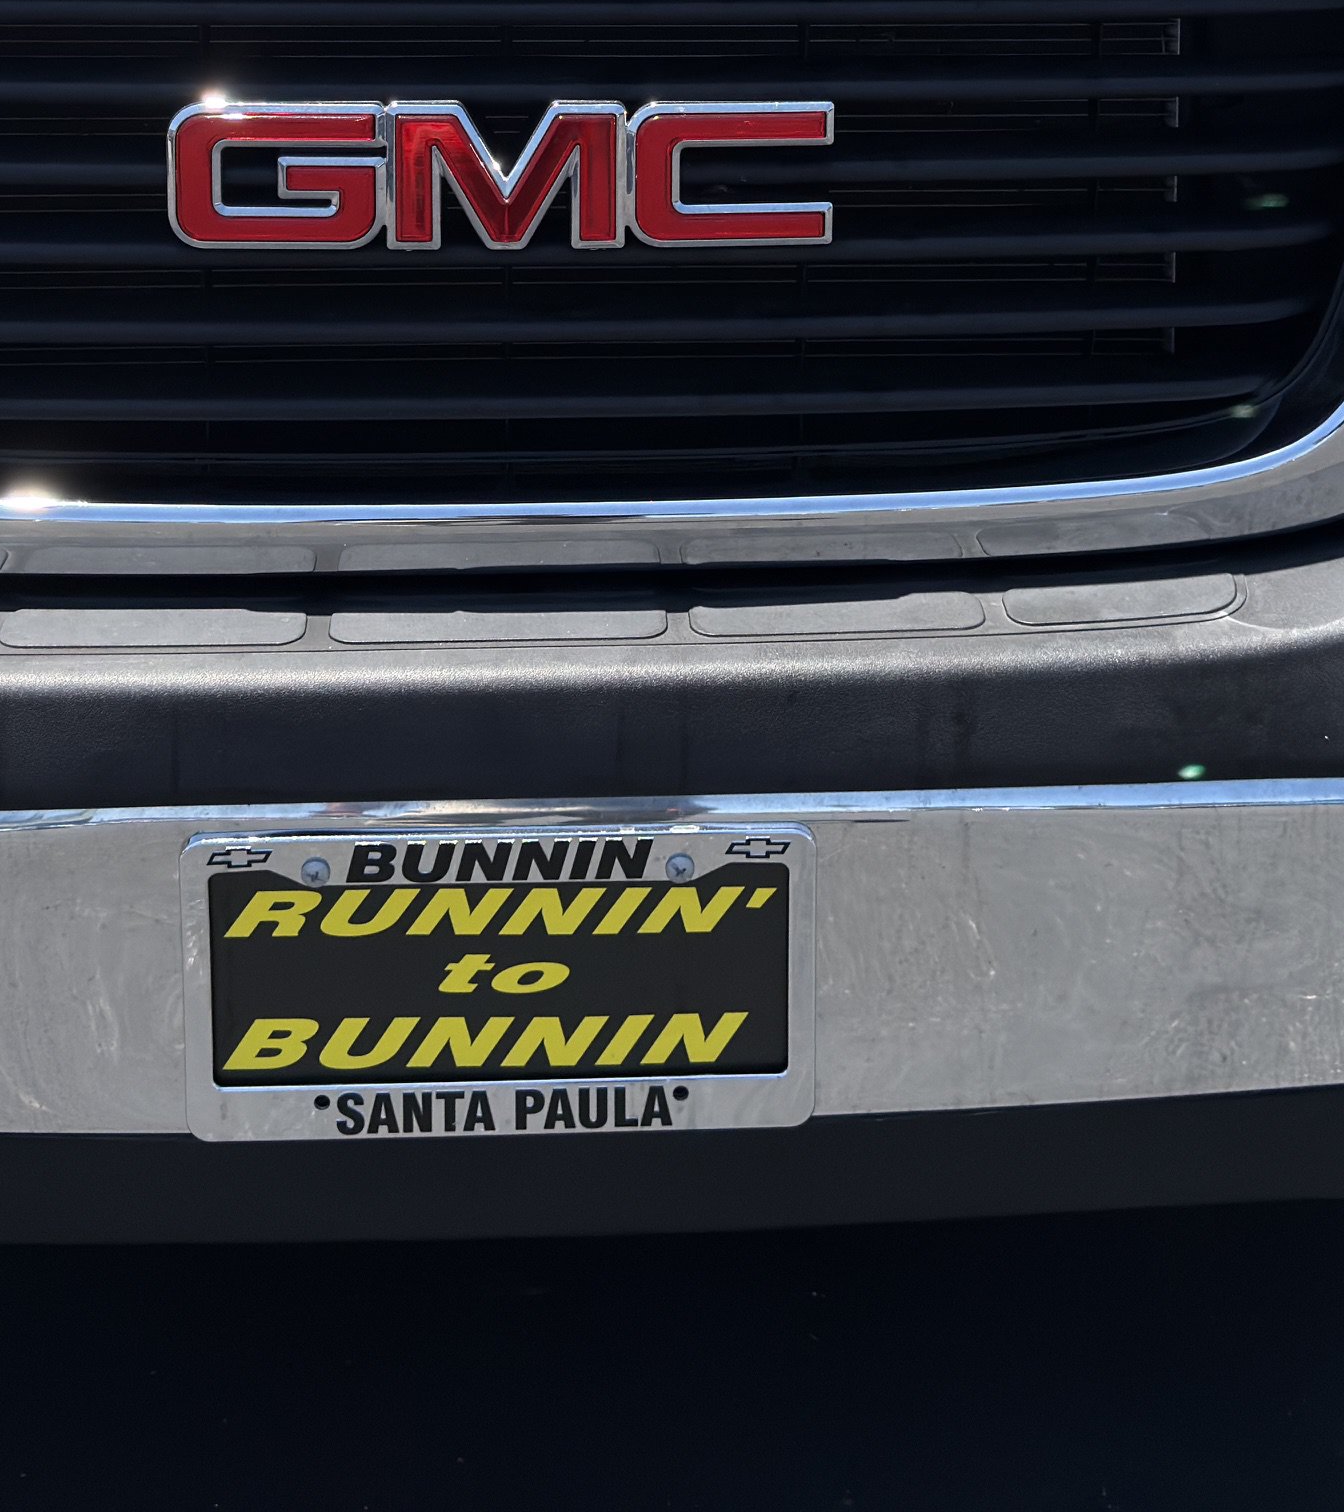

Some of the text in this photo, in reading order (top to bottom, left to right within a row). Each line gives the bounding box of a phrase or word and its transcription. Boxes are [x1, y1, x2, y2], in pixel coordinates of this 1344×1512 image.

[166, 100, 834, 250] GMC
[346, 837, 654, 883] BUNNIN
[224, 886, 777, 937] RUNNIN'
[438, 954, 570, 994] to
[223, 1012, 749, 1070] BUNNIN
[336, 1086, 673, 1135] SANTA PAULA
